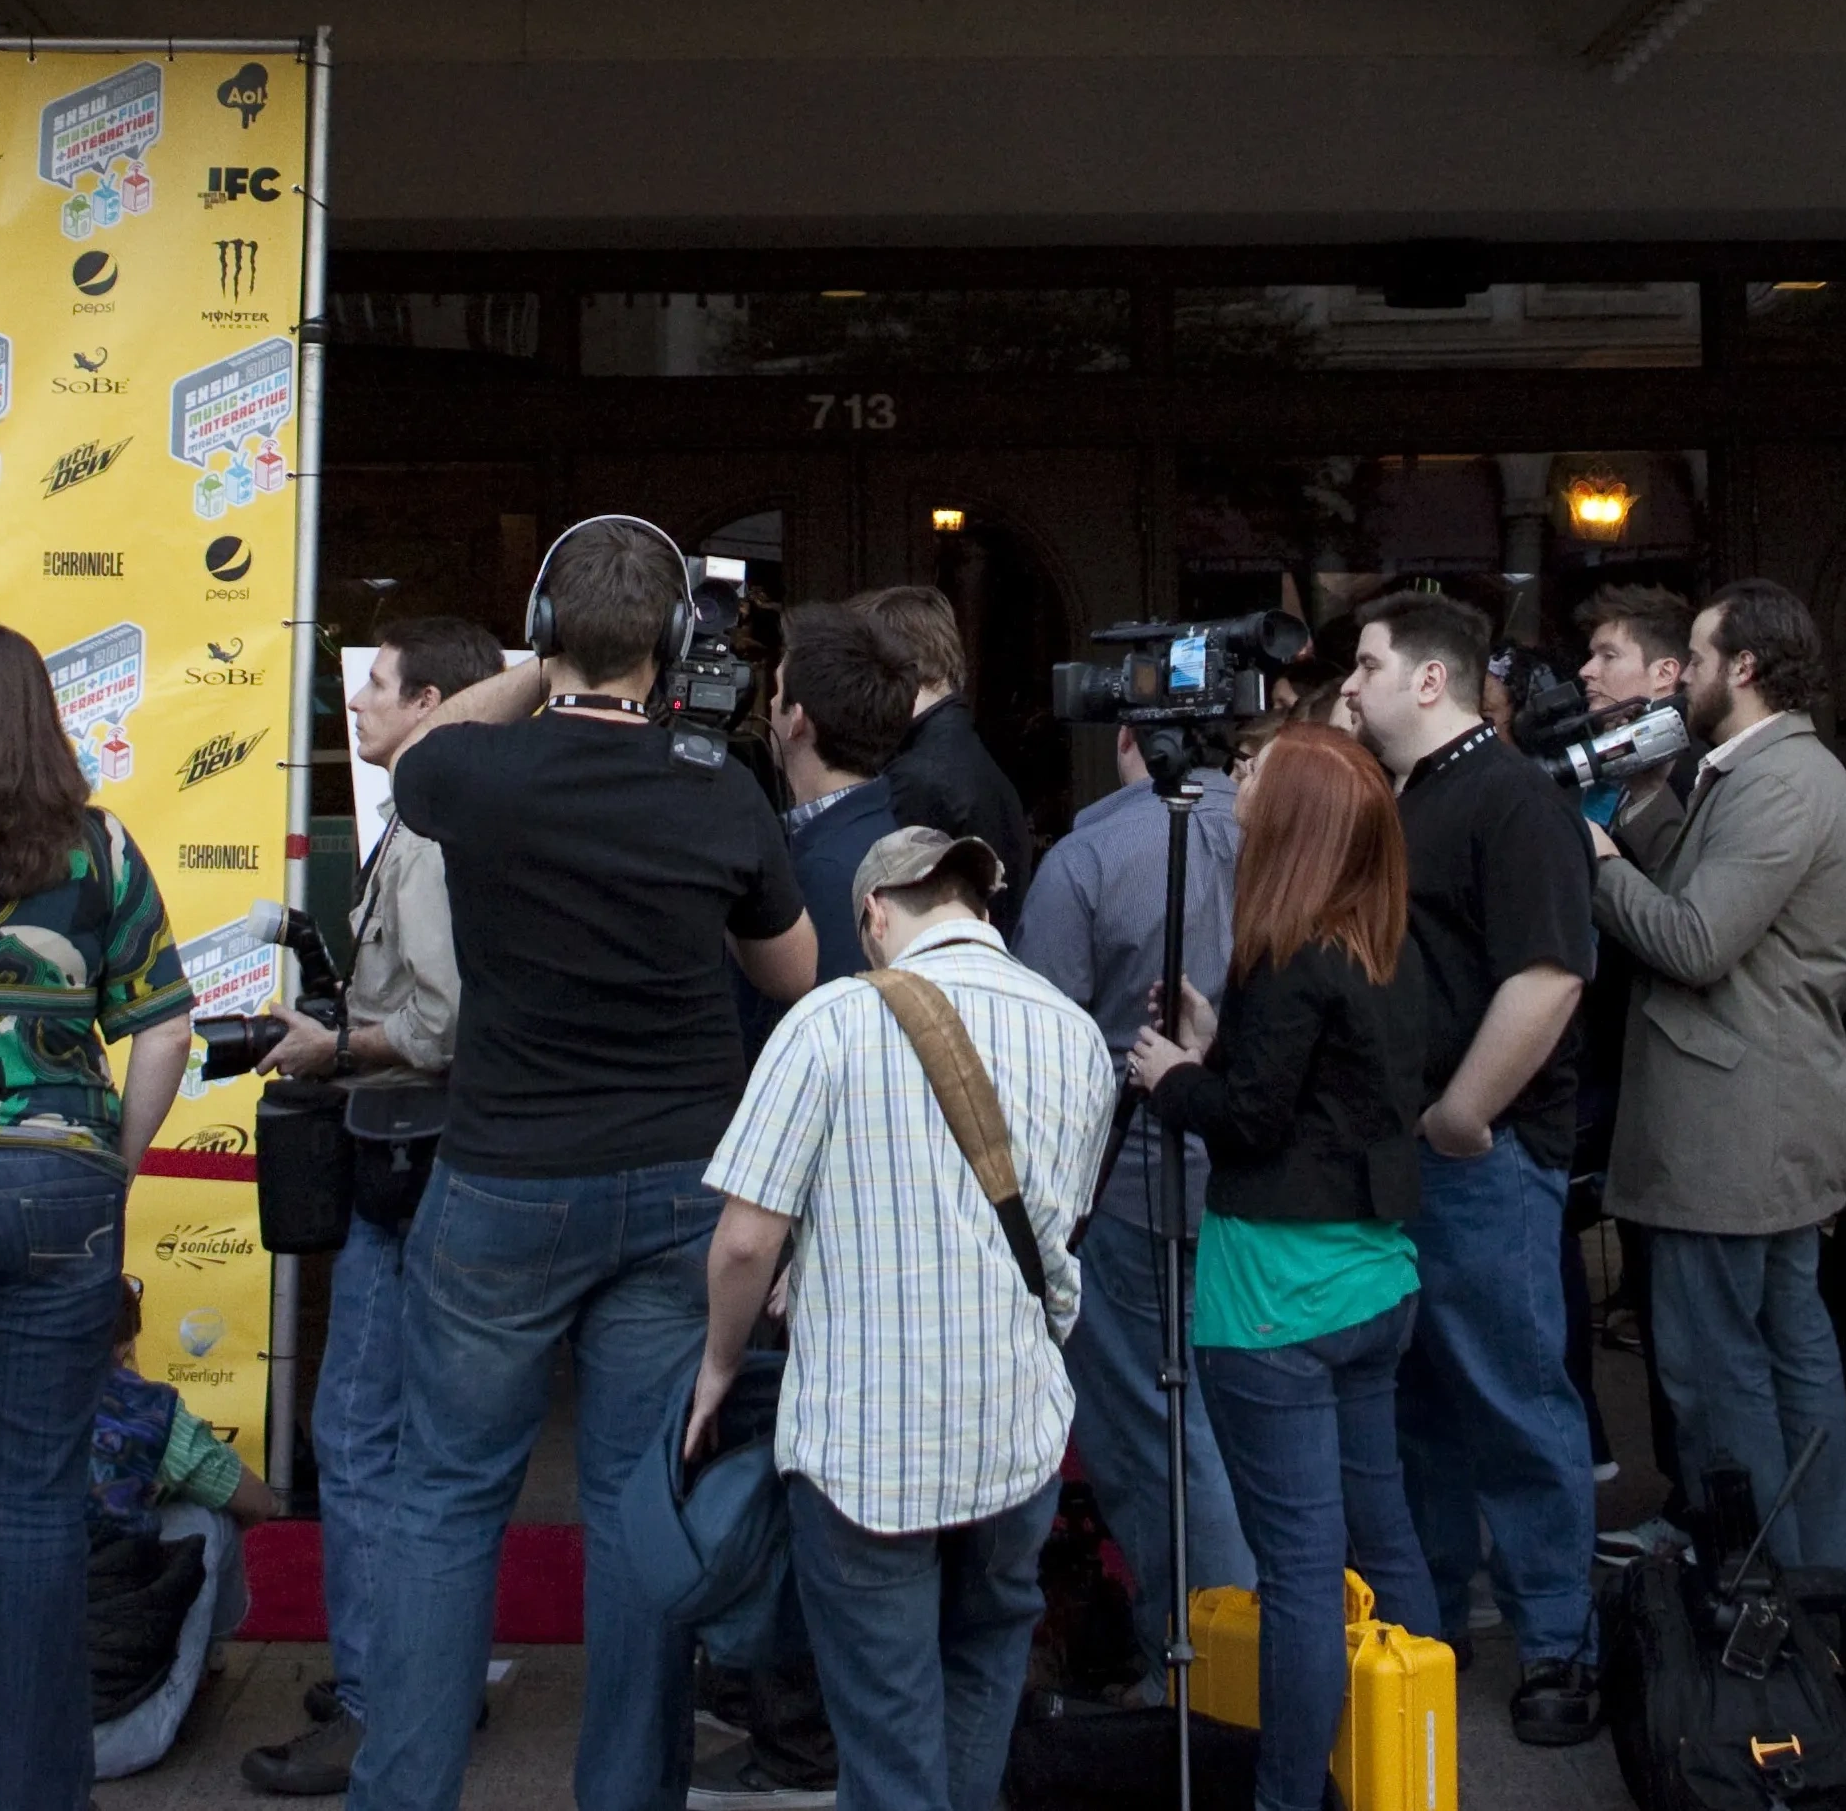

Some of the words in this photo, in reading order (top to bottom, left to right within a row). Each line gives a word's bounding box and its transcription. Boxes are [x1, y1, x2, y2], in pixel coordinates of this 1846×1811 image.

[208, 167, 281, 202] IFC
[73, 302, 115, 315] pepsi
[810, 395, 895, 430] 713
[52, 552, 124, 577] CHRONICLE
[206, 588, 250, 601] pepsi
[187, 844, 259, 869] CHRONICLE
[179, 1238, 254, 1255] sonicbids
[167, 1368, 234, 1386] Silverlight
